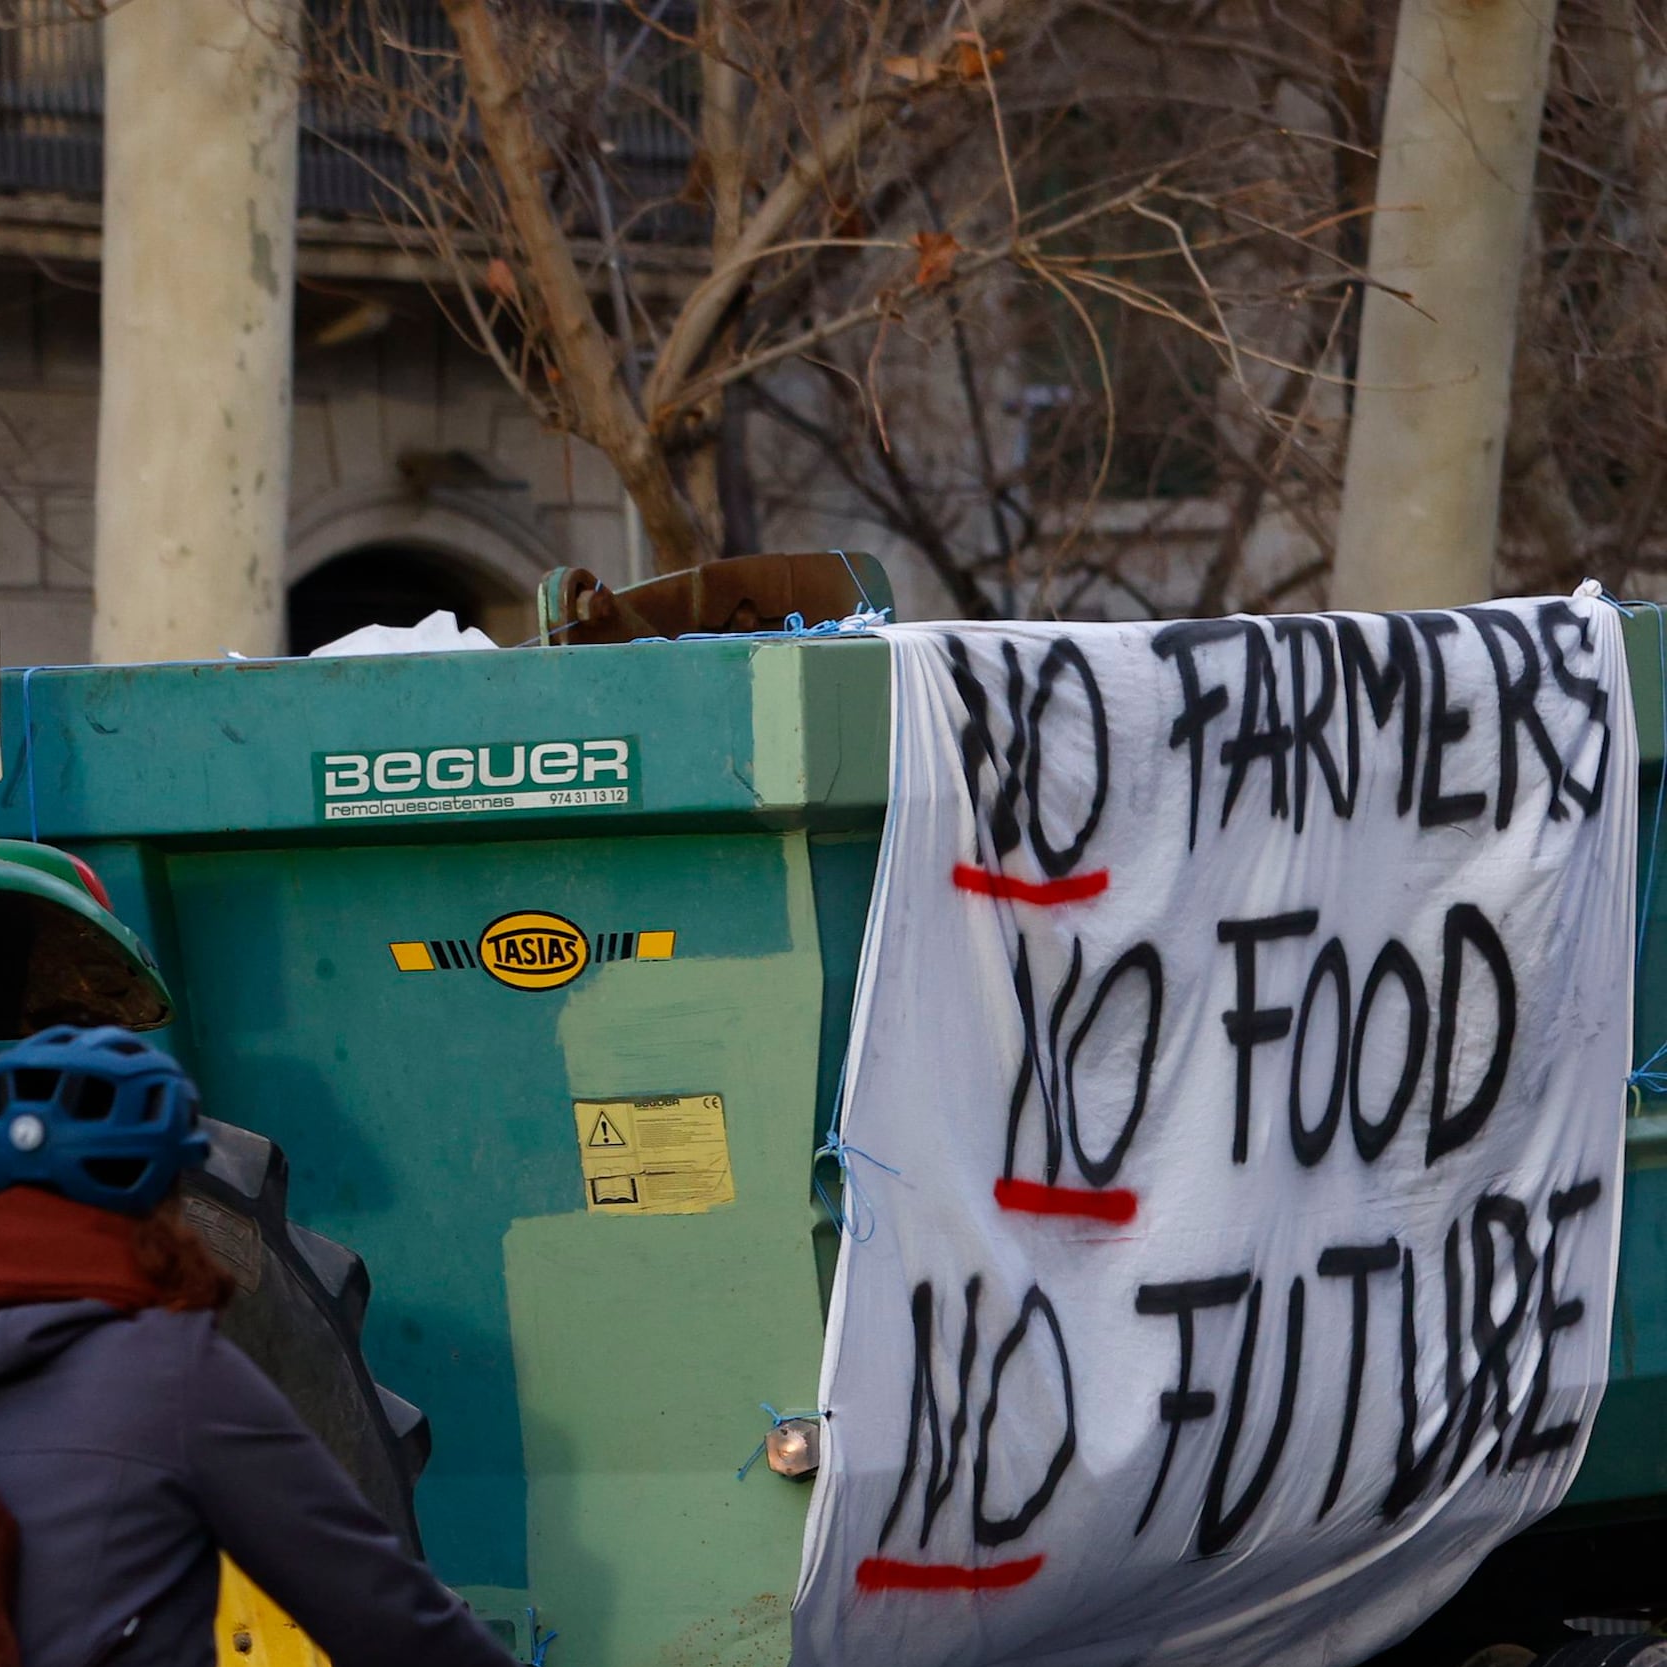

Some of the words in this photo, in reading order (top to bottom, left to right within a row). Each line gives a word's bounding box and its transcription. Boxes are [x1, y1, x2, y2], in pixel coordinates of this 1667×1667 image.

[549, 792, 573, 805] 974
[573, 791, 589, 804] 31
[592, 790, 608, 803] 13
[609, 789, 625, 802] 12
[943, 633, 1110, 879] NO
[1151, 600, 1611, 853] FARMERS
[486, 927, 580, 975] TASIAS
[1002, 932, 1163, 1189] NO
[1217, 902, 1519, 1168] FOOD
[877, 1272, 1078, 1550] NO
[1134, 1178, 1603, 1561] FUTURE
